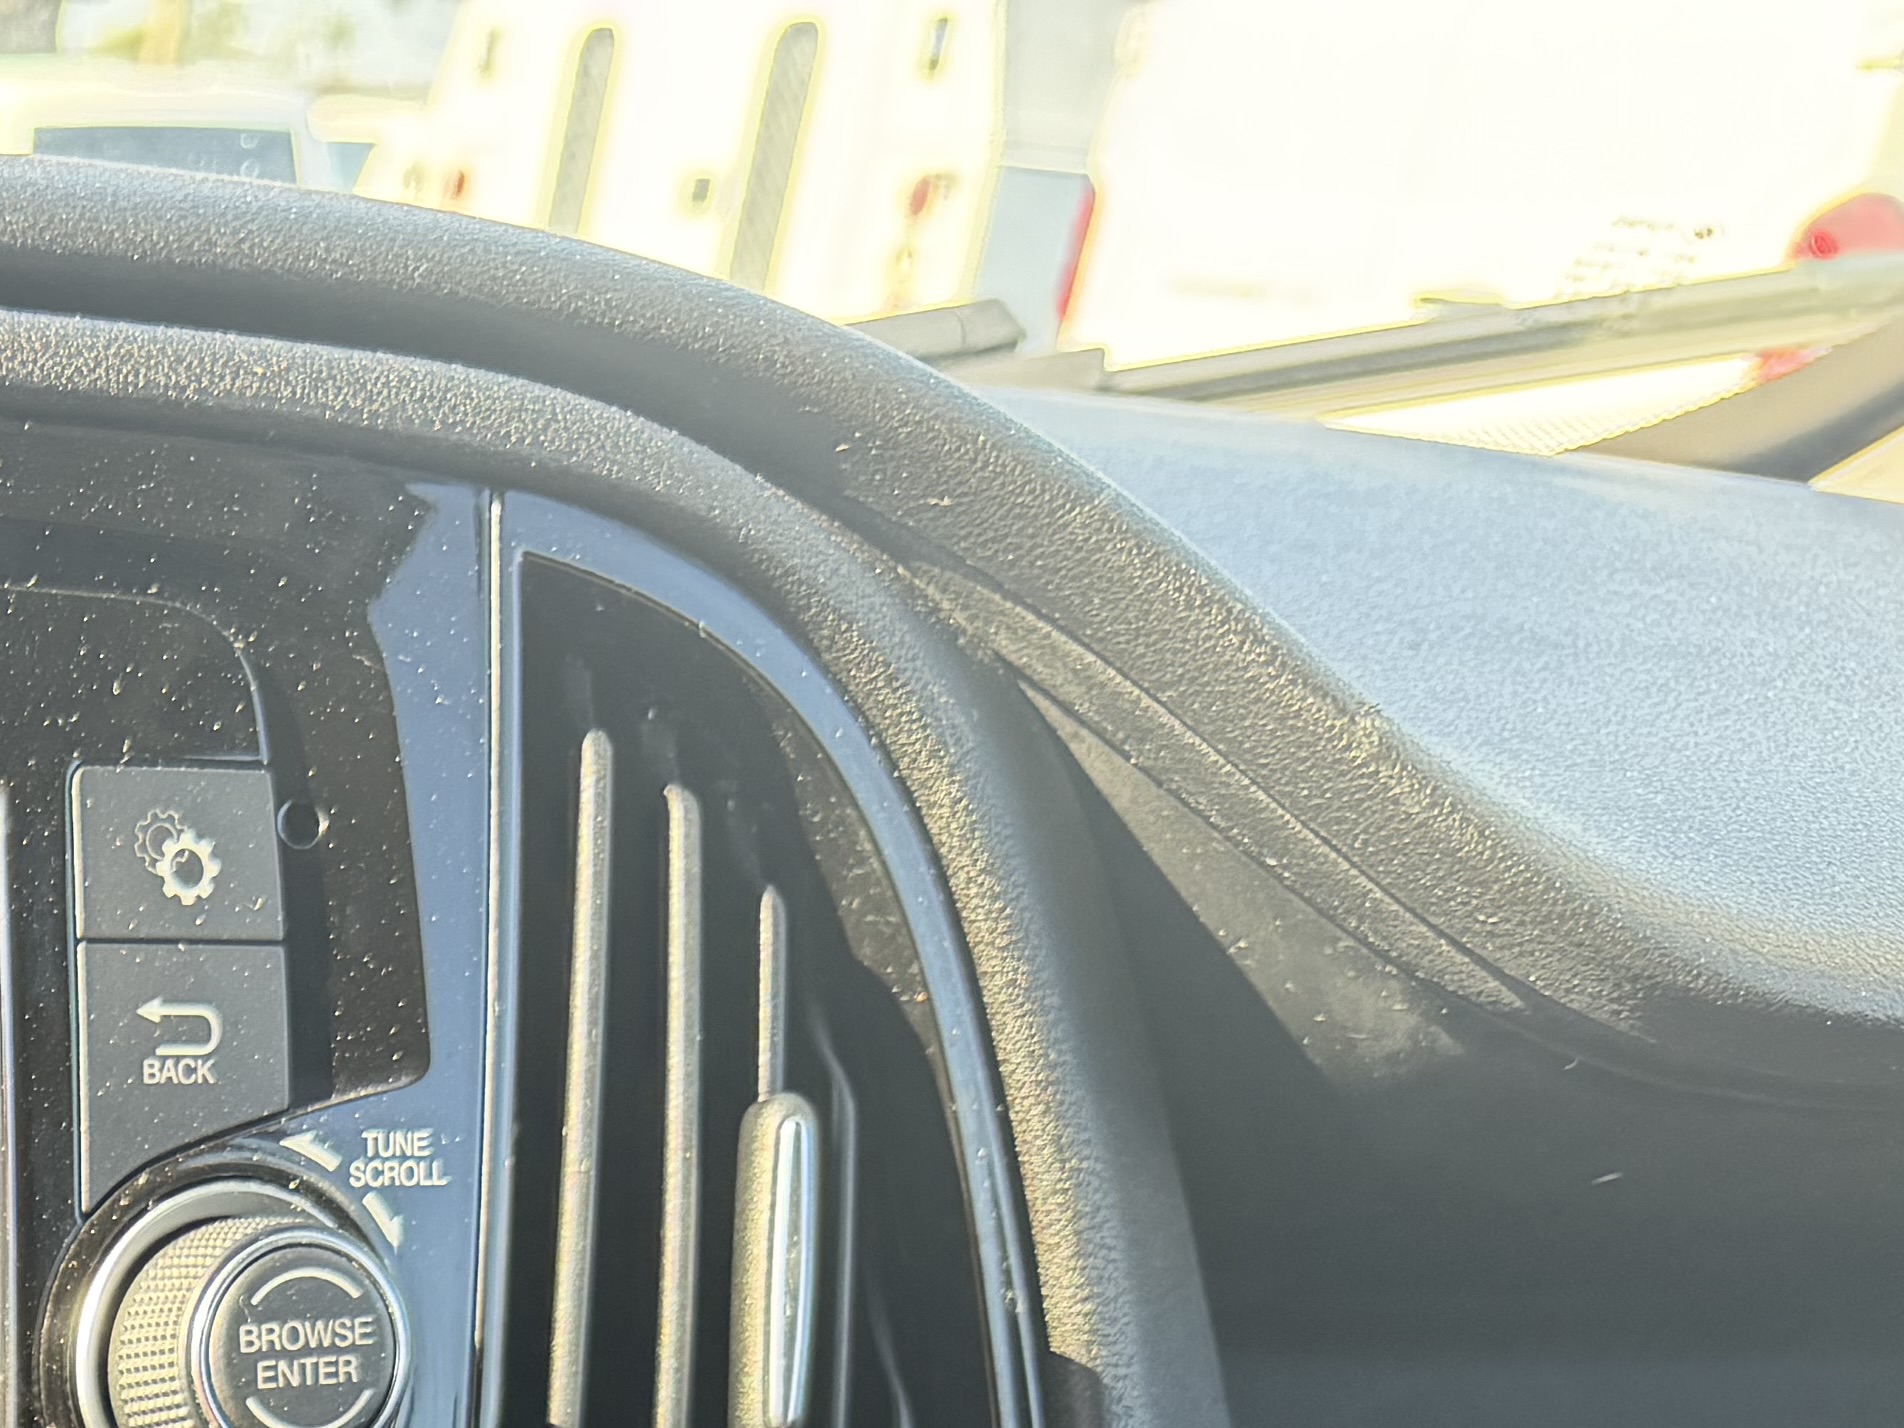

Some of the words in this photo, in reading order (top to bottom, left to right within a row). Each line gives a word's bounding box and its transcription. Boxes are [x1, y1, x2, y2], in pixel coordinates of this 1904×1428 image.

[142, 1056, 218, 1087] BACK
[360, 1127, 435, 1159] TUNE
[348, 1160, 452, 1189] SCROLL
[237, 1314, 376, 1354] BROWSE
[254, 1352, 360, 1390] ENTER
